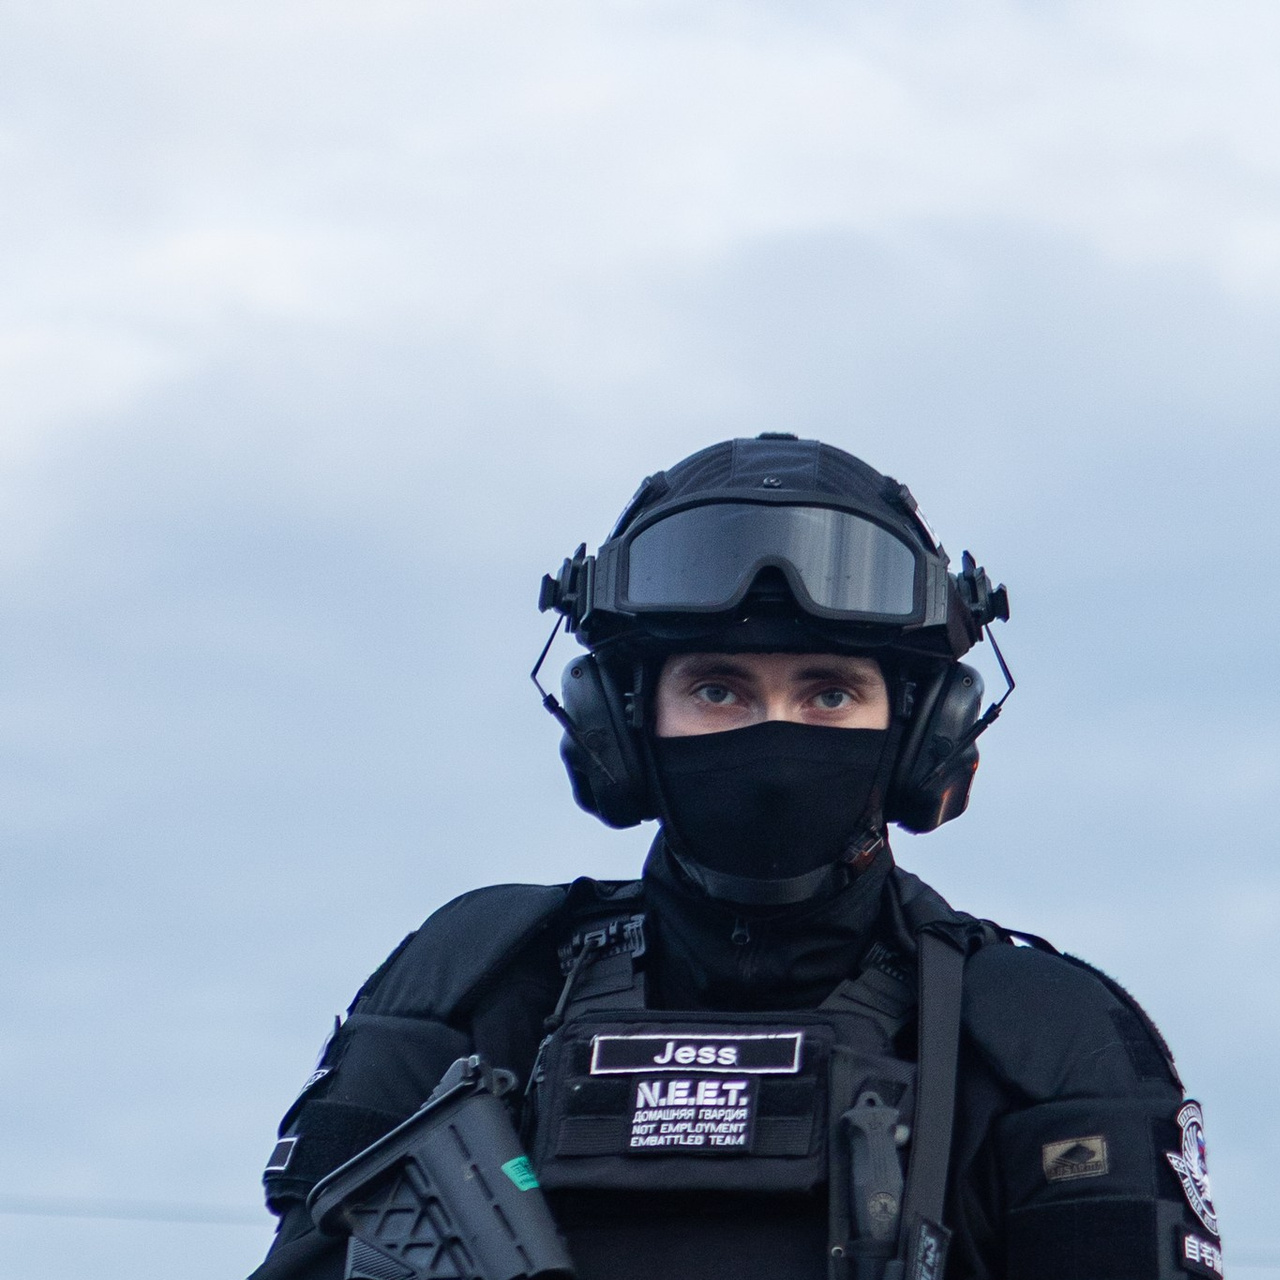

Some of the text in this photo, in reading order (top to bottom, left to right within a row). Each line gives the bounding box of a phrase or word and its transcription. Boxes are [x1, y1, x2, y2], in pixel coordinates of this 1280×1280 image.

[653, 1041, 738, 1065] Jess
[636, 1081, 749, 1108] N.E.E.T.
[632, 1108, 748, 1124] ДОМАШНЯЯ ГВАРДИЯ
[631, 1122, 746, 1135] NOT EMPLOYMENT
[630, 1134, 746, 1147] EMBATTLED TEAM
